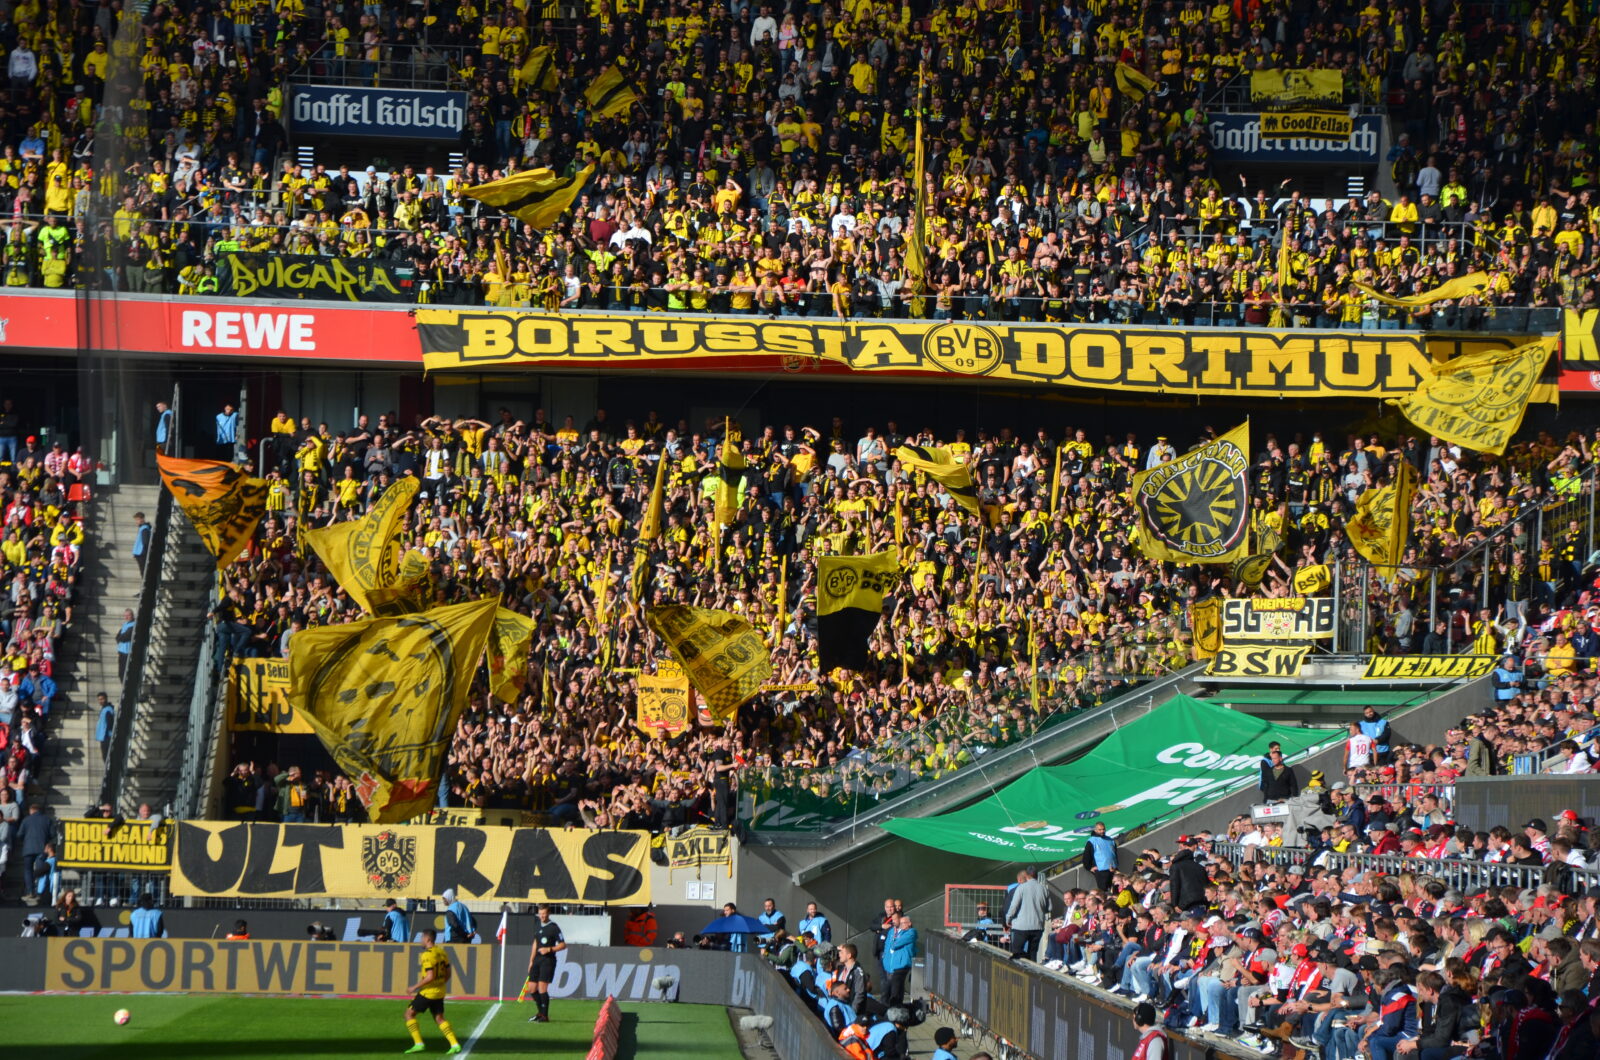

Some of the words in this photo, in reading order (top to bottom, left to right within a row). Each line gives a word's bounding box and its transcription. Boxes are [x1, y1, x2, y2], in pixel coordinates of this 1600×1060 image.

[294, 93, 372, 126] Gaffel
[376, 96, 463, 132] Kölsch
[1281, 116, 1349, 132] GoodFellas
[182, 310, 316, 350] REWE
[462, 317, 917, 365] BORUSSIA
[937, 328, 993, 359] BVB
[955, 358, 975, 367] 09
[1297, 566, 1328, 591] BSW
[1225, 601, 1261, 633] SG
[1295, 600, 1334, 632] RB
[1213, 649, 1305, 675] BSW
[1372, 657, 1491, 676] WEIMAR
[638, 686, 657, 695] THE
[660, 687, 686, 696] UNITY
[1356, 744, 1367, 755] 10
[64, 823, 167, 844] HOOLGANS
[63, 842, 167, 864] DORTMUND
[178, 821, 344, 894] ULT
[432, 826, 643, 901] RAS
[380, 852, 399, 866] BVB
[61, 939, 484, 994] SPORTWETTEN
[435, 961, 446, 979] 13
[548, 948, 680, 998] bwin
